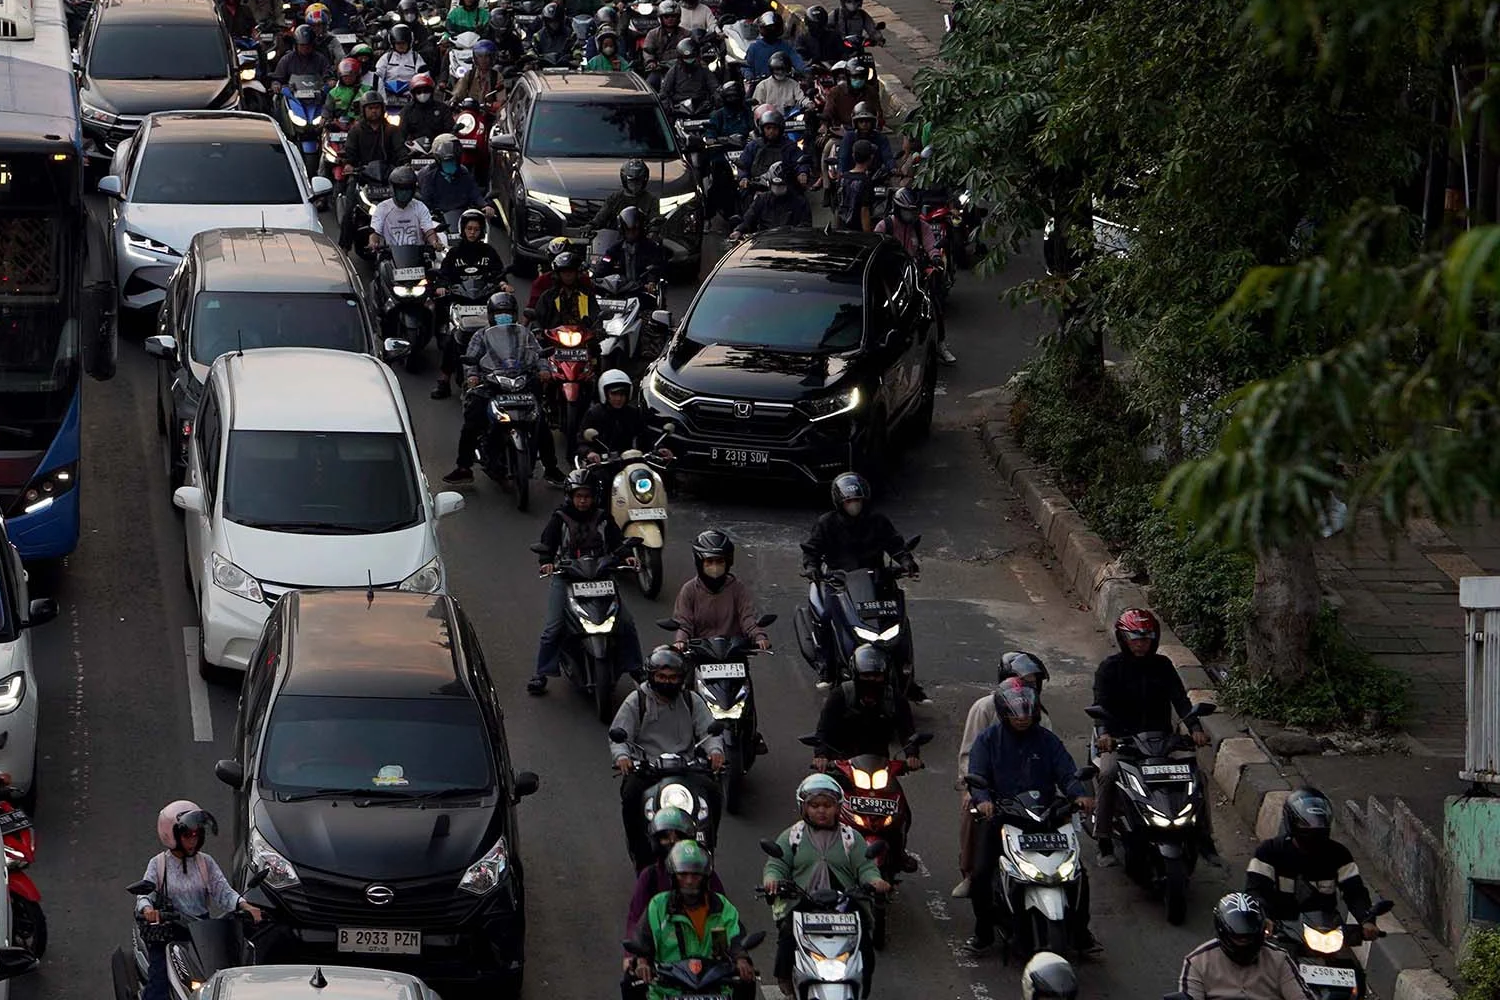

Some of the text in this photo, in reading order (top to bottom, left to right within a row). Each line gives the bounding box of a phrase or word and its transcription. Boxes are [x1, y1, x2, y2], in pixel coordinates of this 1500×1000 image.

[711, 448, 768, 463] B 2319 SDW
[340, 931, 418, 946] B 2933 PZM
